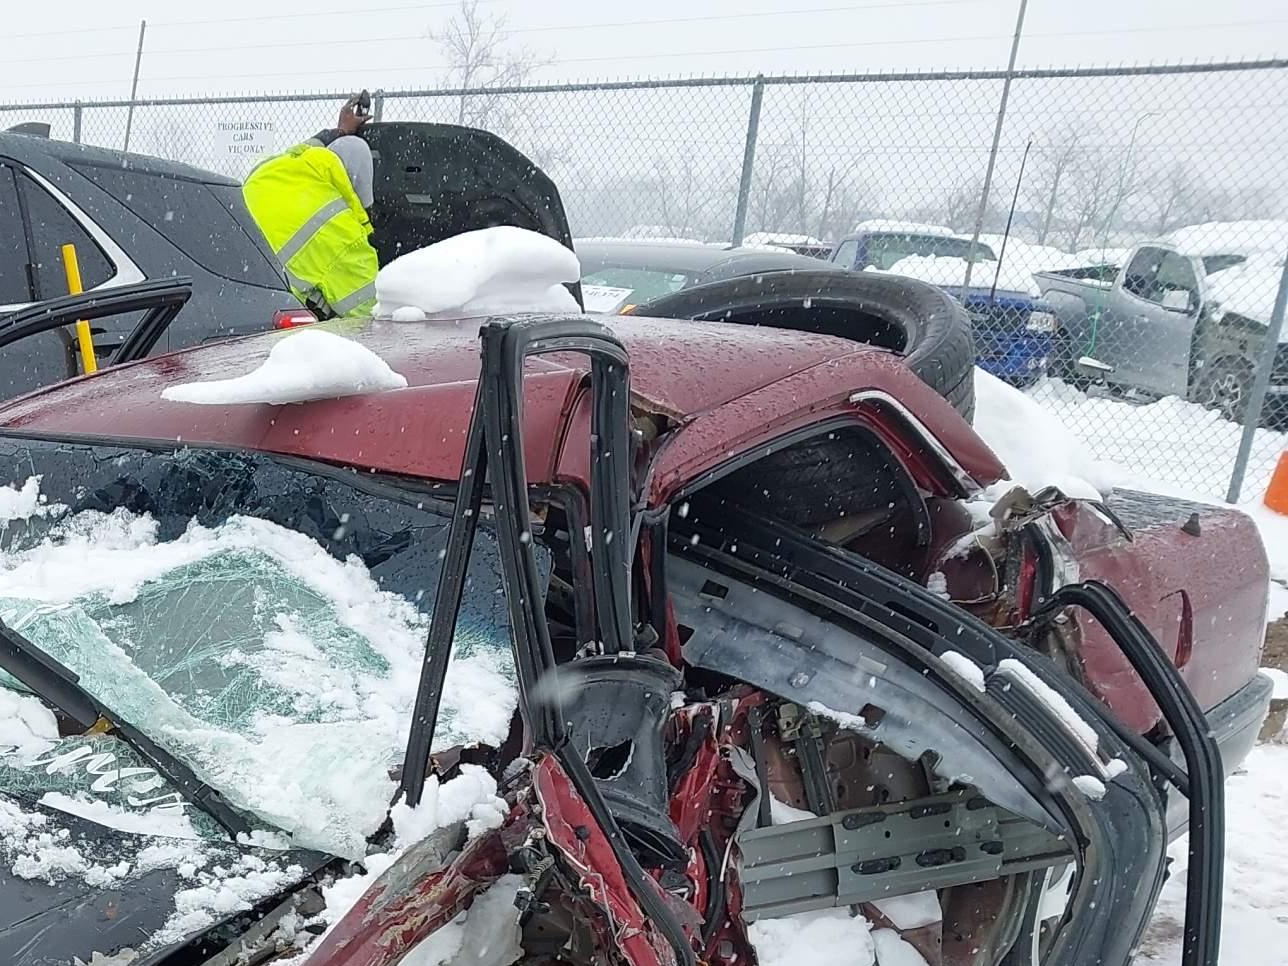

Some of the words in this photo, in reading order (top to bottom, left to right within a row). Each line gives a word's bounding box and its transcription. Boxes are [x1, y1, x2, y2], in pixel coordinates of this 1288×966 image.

[217, 122, 273, 131] PROGRESSIVE
[233, 132, 254, 141] CARS
[244, 145, 265, 153] ONLY
